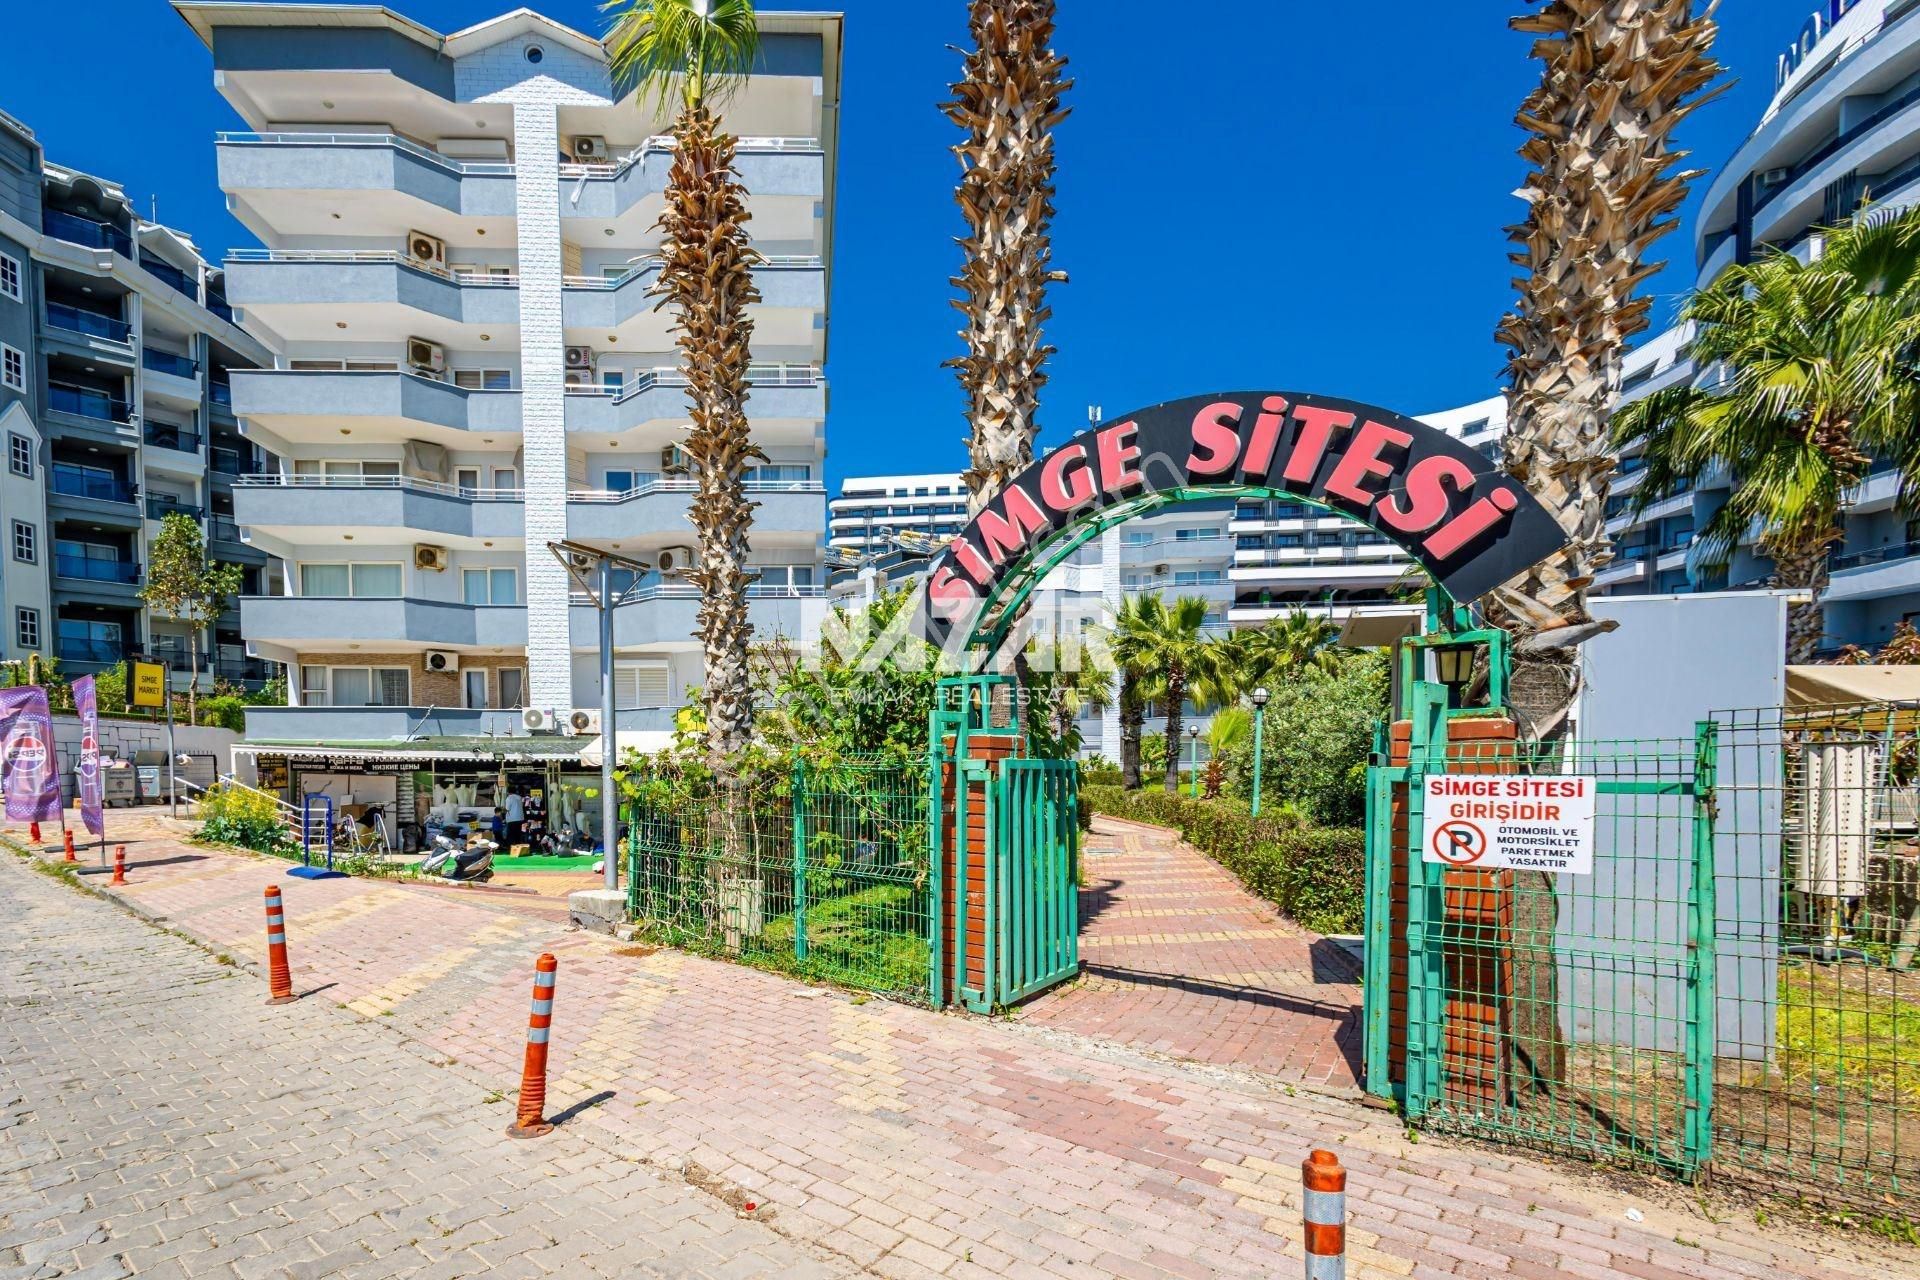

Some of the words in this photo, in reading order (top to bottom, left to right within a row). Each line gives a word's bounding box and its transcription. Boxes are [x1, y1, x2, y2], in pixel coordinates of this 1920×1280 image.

[138, 686, 159, 694] MARKET
[1430, 778, 1500, 797] SİMGE
[1506, 778, 1583, 798] SİTESİ
[1450, 800, 1561, 823] GİRİŞİDİR
[1562, 828, 1578, 837] VE
[1501, 847, 1532, 856] PARK
[1534, 848, 1576, 858] ETMEK
[1509, 857, 1568, 868] YASAKTIR
